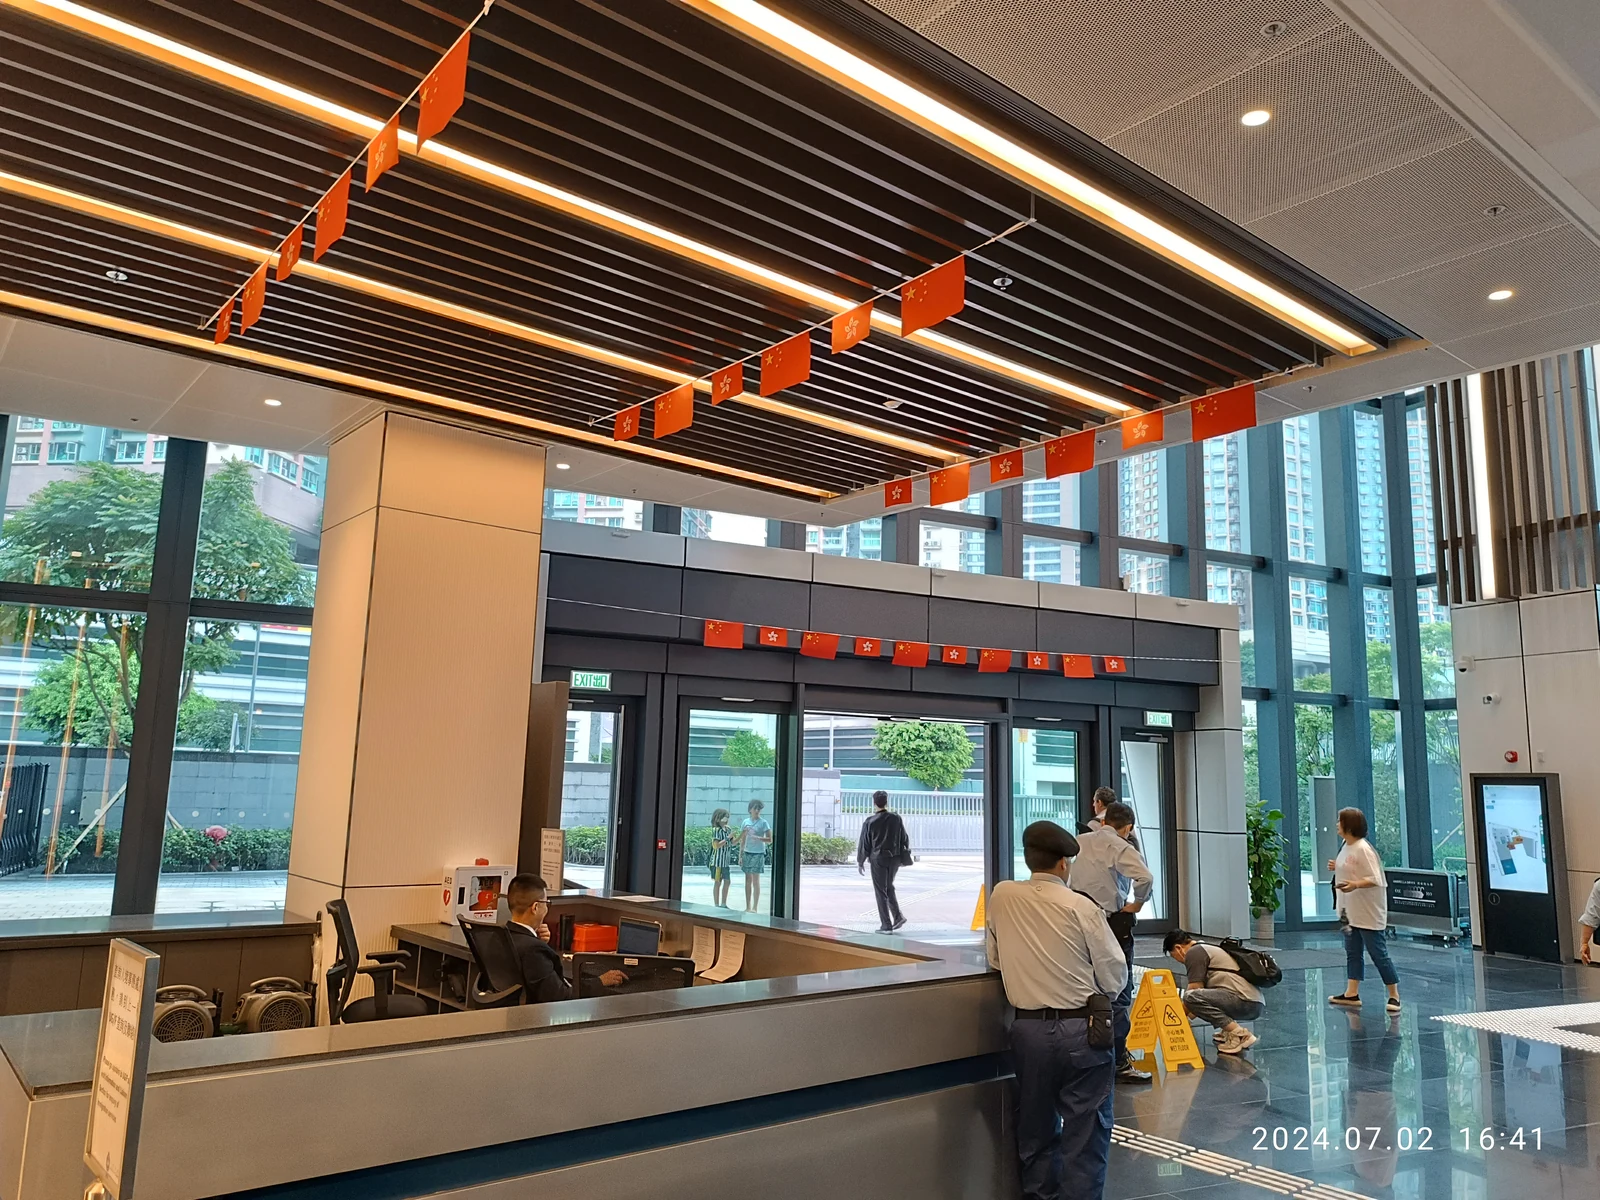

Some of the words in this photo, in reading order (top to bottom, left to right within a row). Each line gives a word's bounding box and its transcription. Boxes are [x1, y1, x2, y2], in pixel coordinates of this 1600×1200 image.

[574, 673, 593, 687] EXIT
[593, 674, 608, 688] 出口
[444, 876, 452, 885] AED
